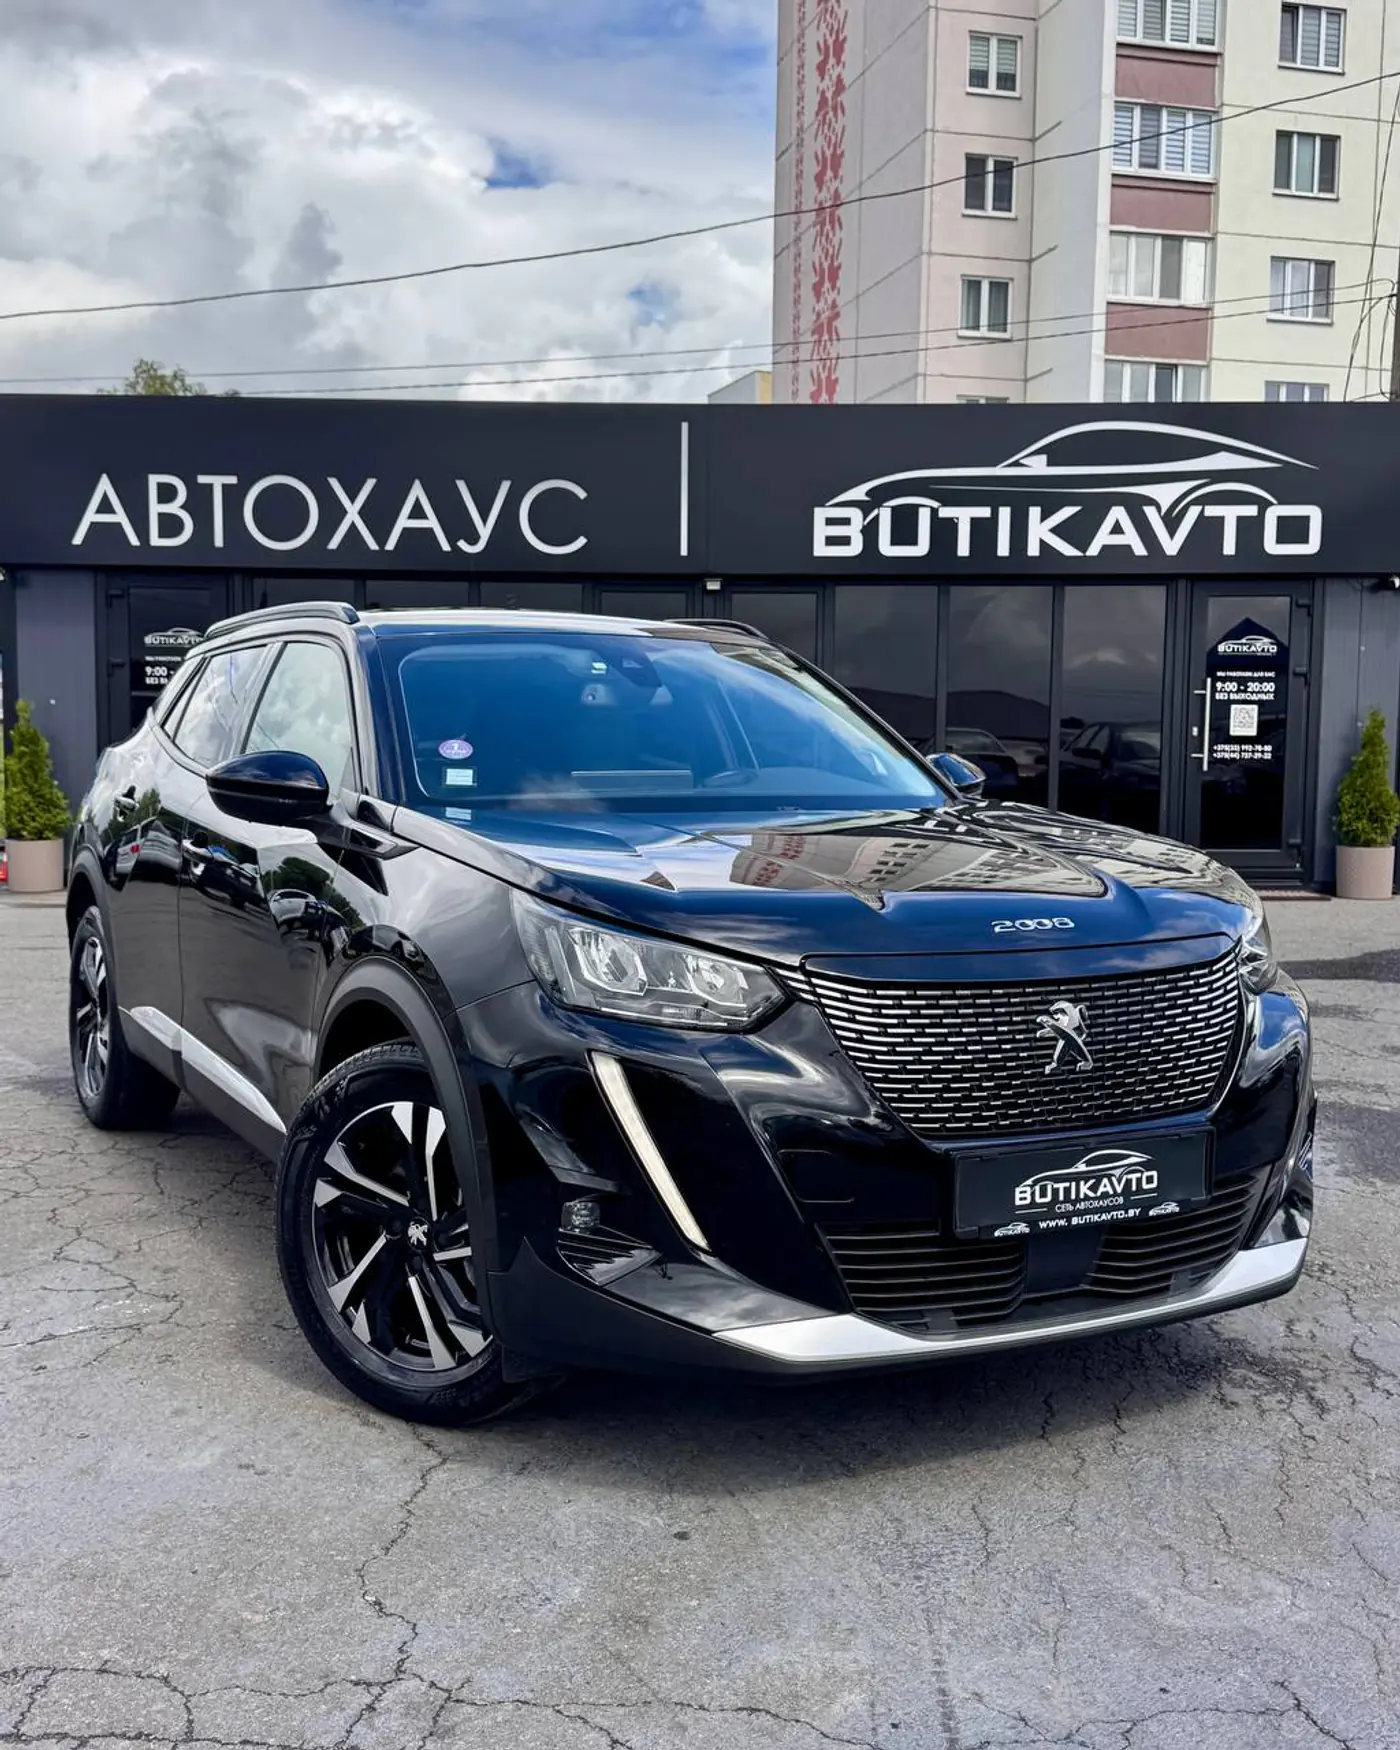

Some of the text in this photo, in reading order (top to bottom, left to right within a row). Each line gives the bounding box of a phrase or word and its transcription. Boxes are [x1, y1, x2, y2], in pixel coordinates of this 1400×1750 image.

[71, 472, 589, 555] АВТОХАУС
[812, 504, 1323, 558] BUTIKAVTO
[1217, 644, 1278, 653] BUTIKAVTO
[145, 666, 168, 677] 9:00
[1215, 681, 1238, 692] 9:00
[1246, 681, 1276, 692] 20:00
[1215, 692, 1275, 701] БЕЗ ВЫХОДНЫХ
[991, 916, 1076, 934] 2008
[1014, 1170, 1159, 1206] BUTIKAVTO
[1055, 1196, 1125, 1213] СЕТЬ АВТОХАУСОВ
[1071, 1207, 1142, 1226] BUTIKAVTO.BY
